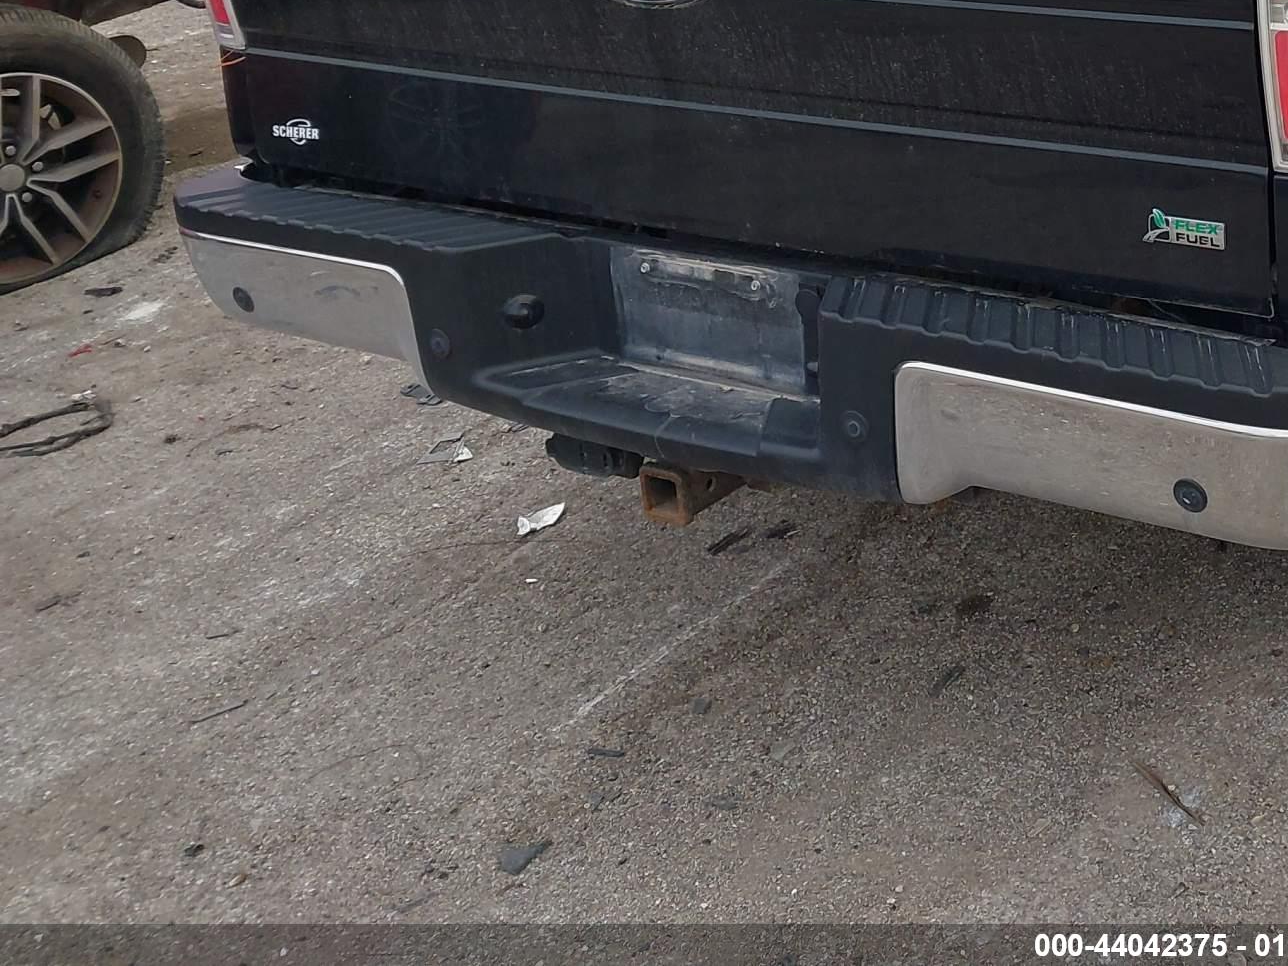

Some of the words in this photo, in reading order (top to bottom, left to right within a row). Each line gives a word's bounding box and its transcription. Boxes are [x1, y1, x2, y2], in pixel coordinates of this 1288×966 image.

[272, 124, 320, 140] SCHERER
[1175, 219, 1218, 235] FLEX
[1176, 232, 1220, 247] FUEL
